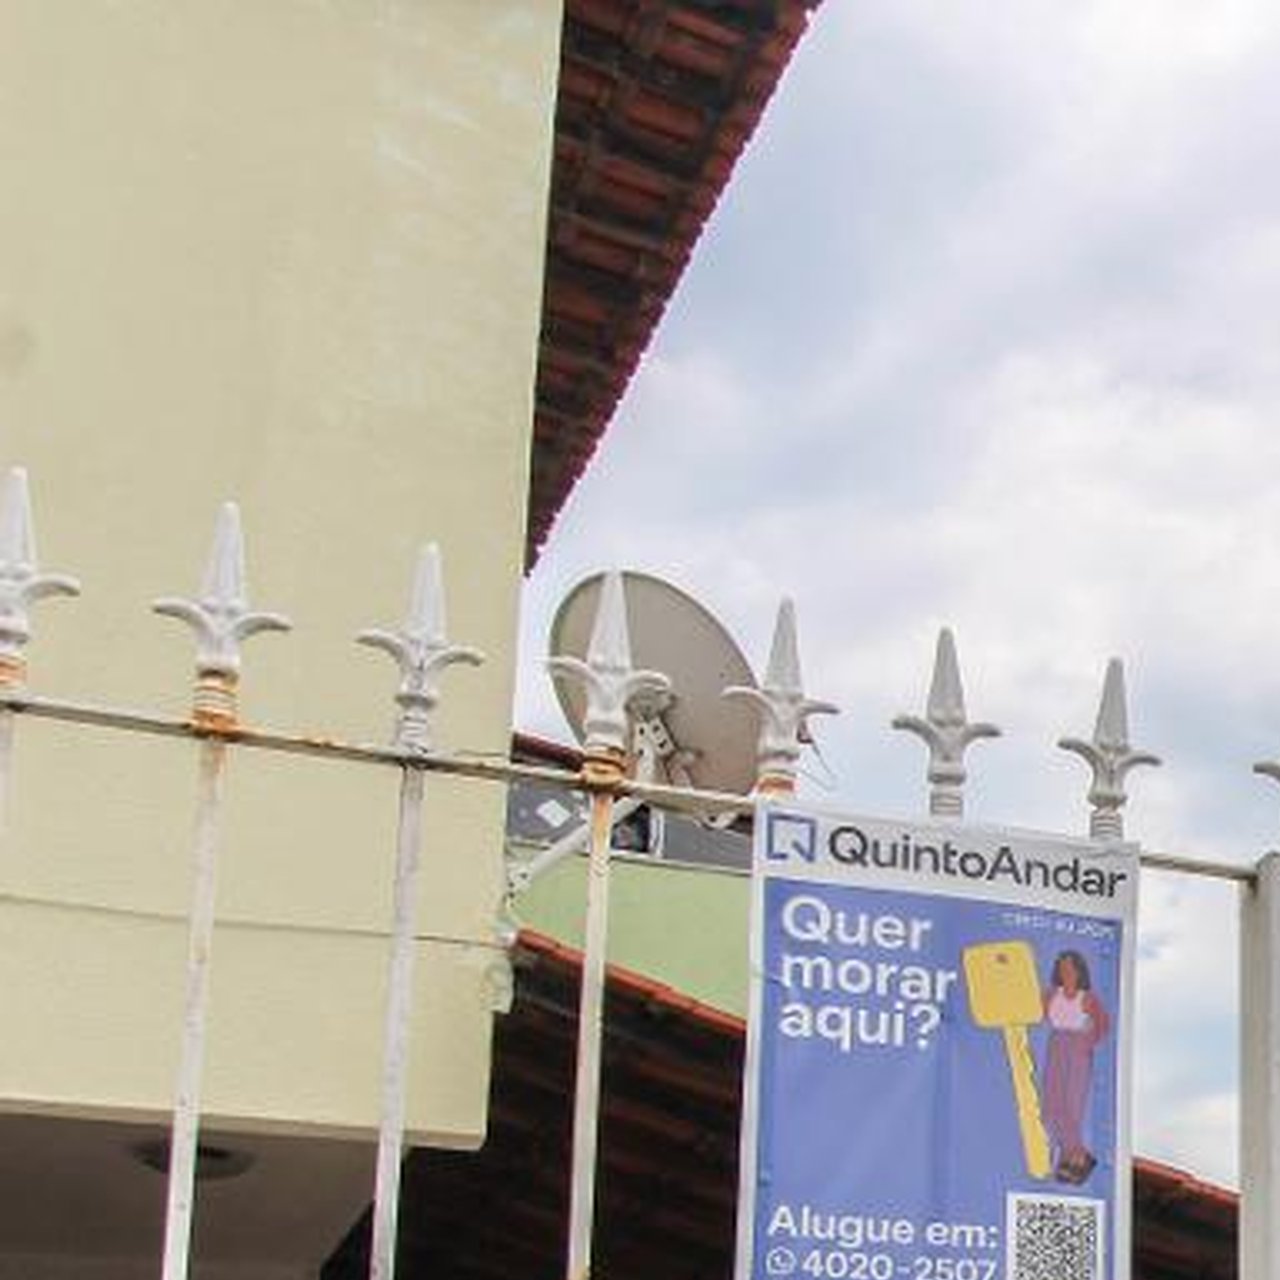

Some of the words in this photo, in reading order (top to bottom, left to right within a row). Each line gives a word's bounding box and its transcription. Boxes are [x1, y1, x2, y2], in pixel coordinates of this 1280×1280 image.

[828, 825, 1127, 898] QuintoAndar
[781, 894, 933, 951] Quer
[780, 951, 958, 1002] morar
[778, 1002, 941, 1052] aqui?
[767, 1205, 915, 1249] Alugue
[926, 1221, 1000, 1249] em:
